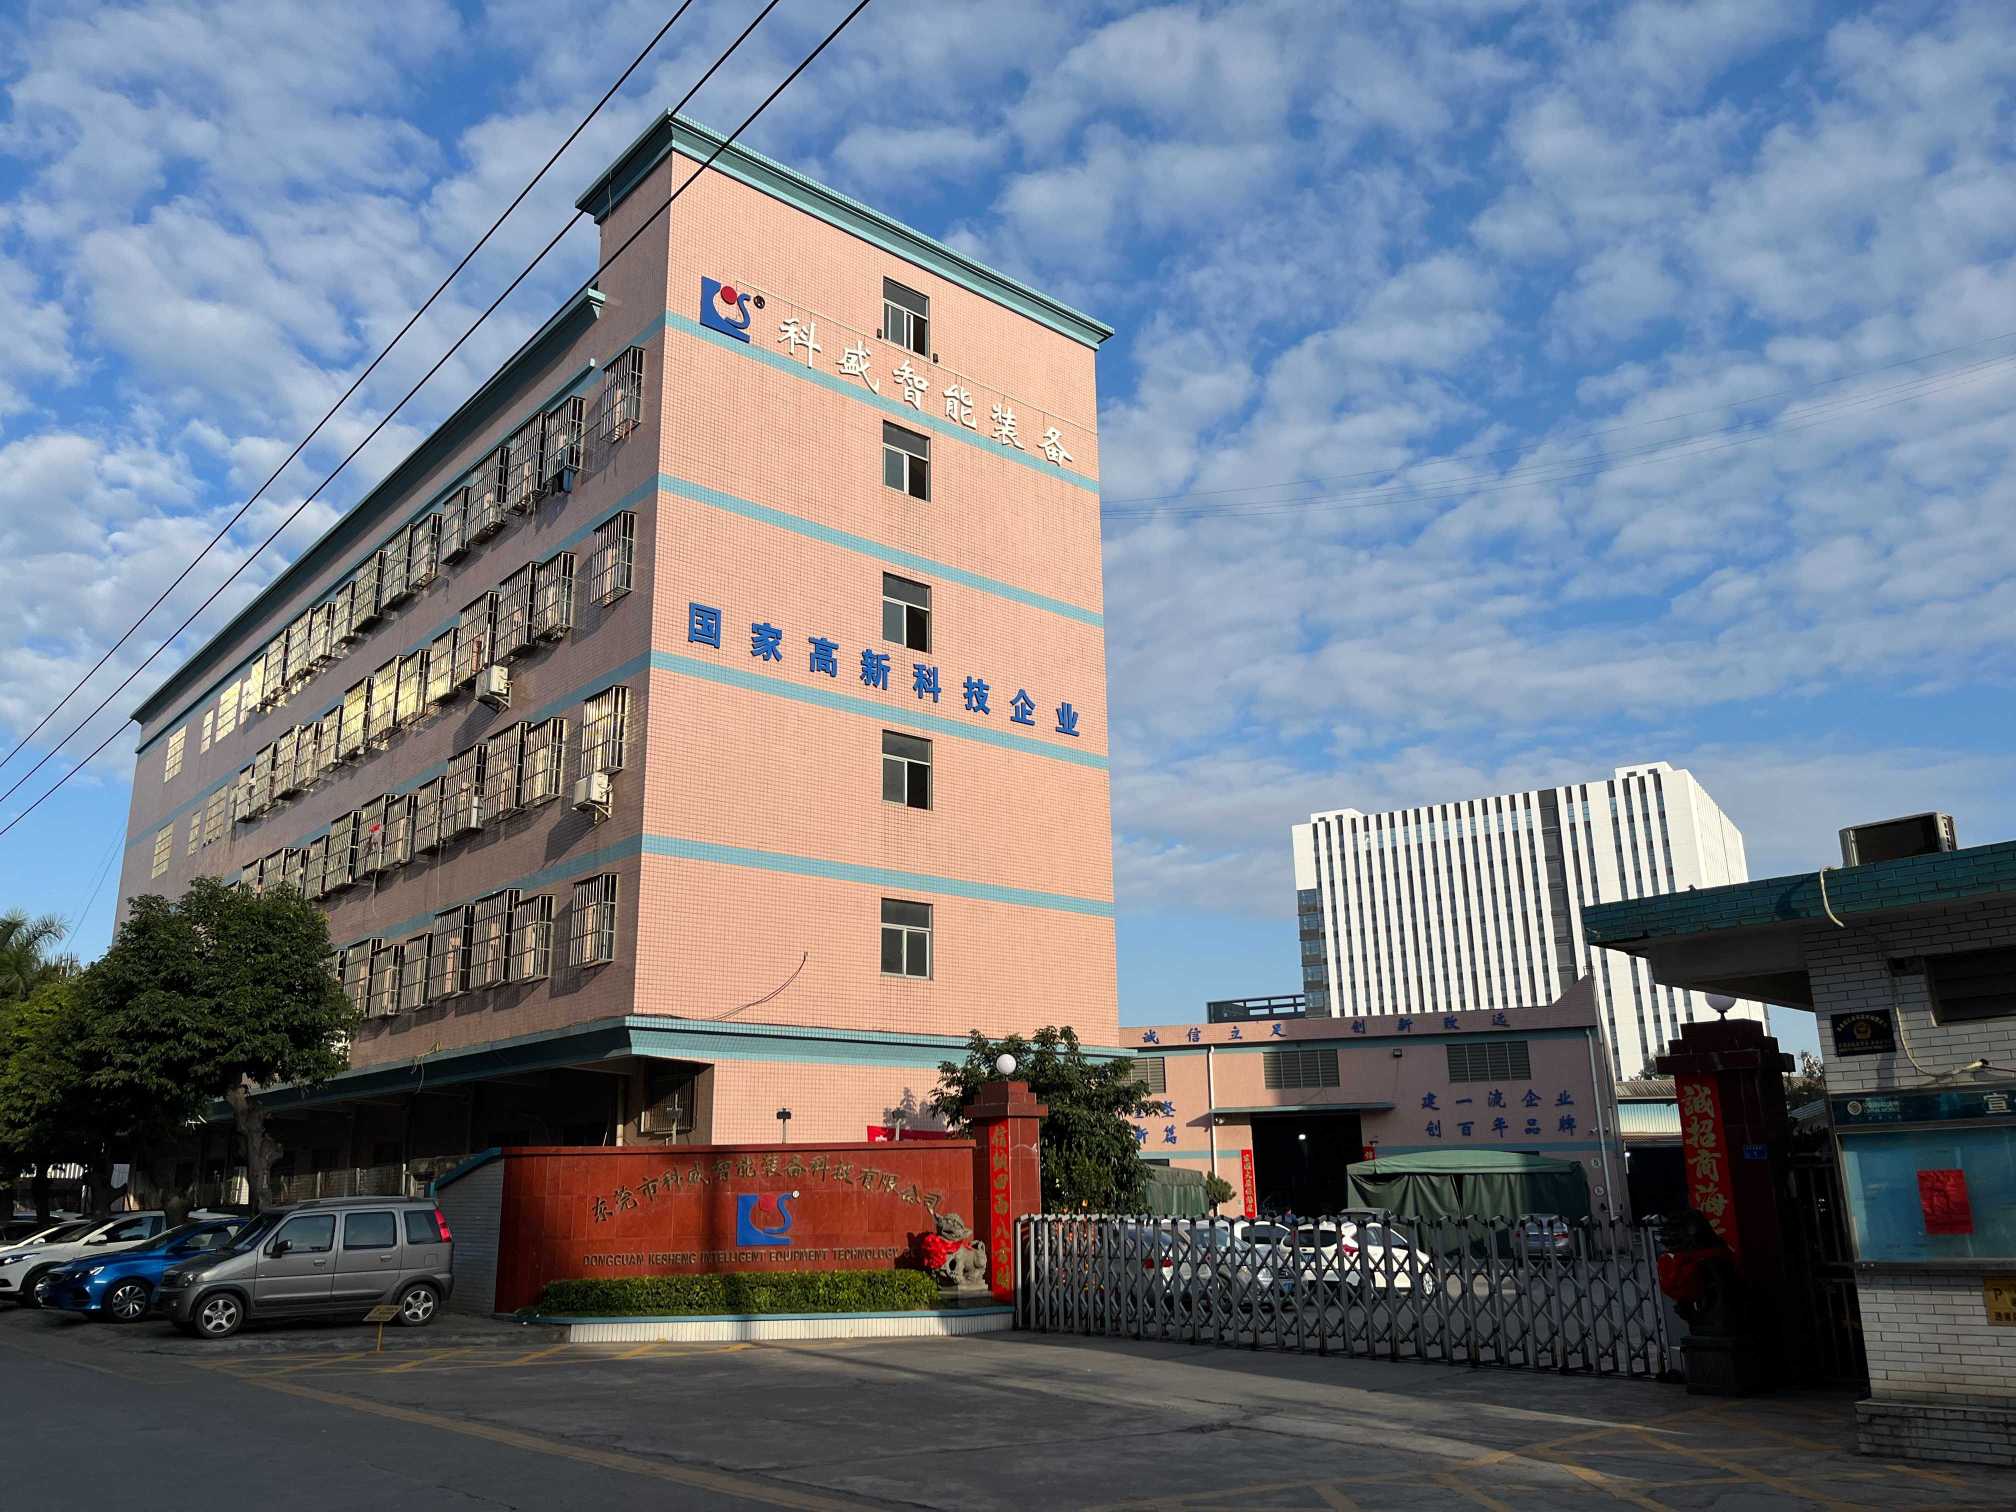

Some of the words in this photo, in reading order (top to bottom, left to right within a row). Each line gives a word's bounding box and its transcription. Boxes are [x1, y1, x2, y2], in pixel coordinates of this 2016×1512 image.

[778, 317, 1073, 466] 科盛智能装备
[688, 602, 1080, 737] 国家高新科技企业
[1143, 1024, 1288, 1045] 诚信立足
[1421, 1089, 1575, 1110] 建一流企业
[1424, 1115, 1577, 1138] 创百年品牌
[583, 1253, 643, 1266] DONGGUAN
[648, 1252, 696, 1265] KESHENG
[701, 1251, 765, 1264] INTELLIGENT
[769, 1250, 828, 1262] EQUIPMENT
[833, 1248, 898, 1260] TECHNOLOGY
